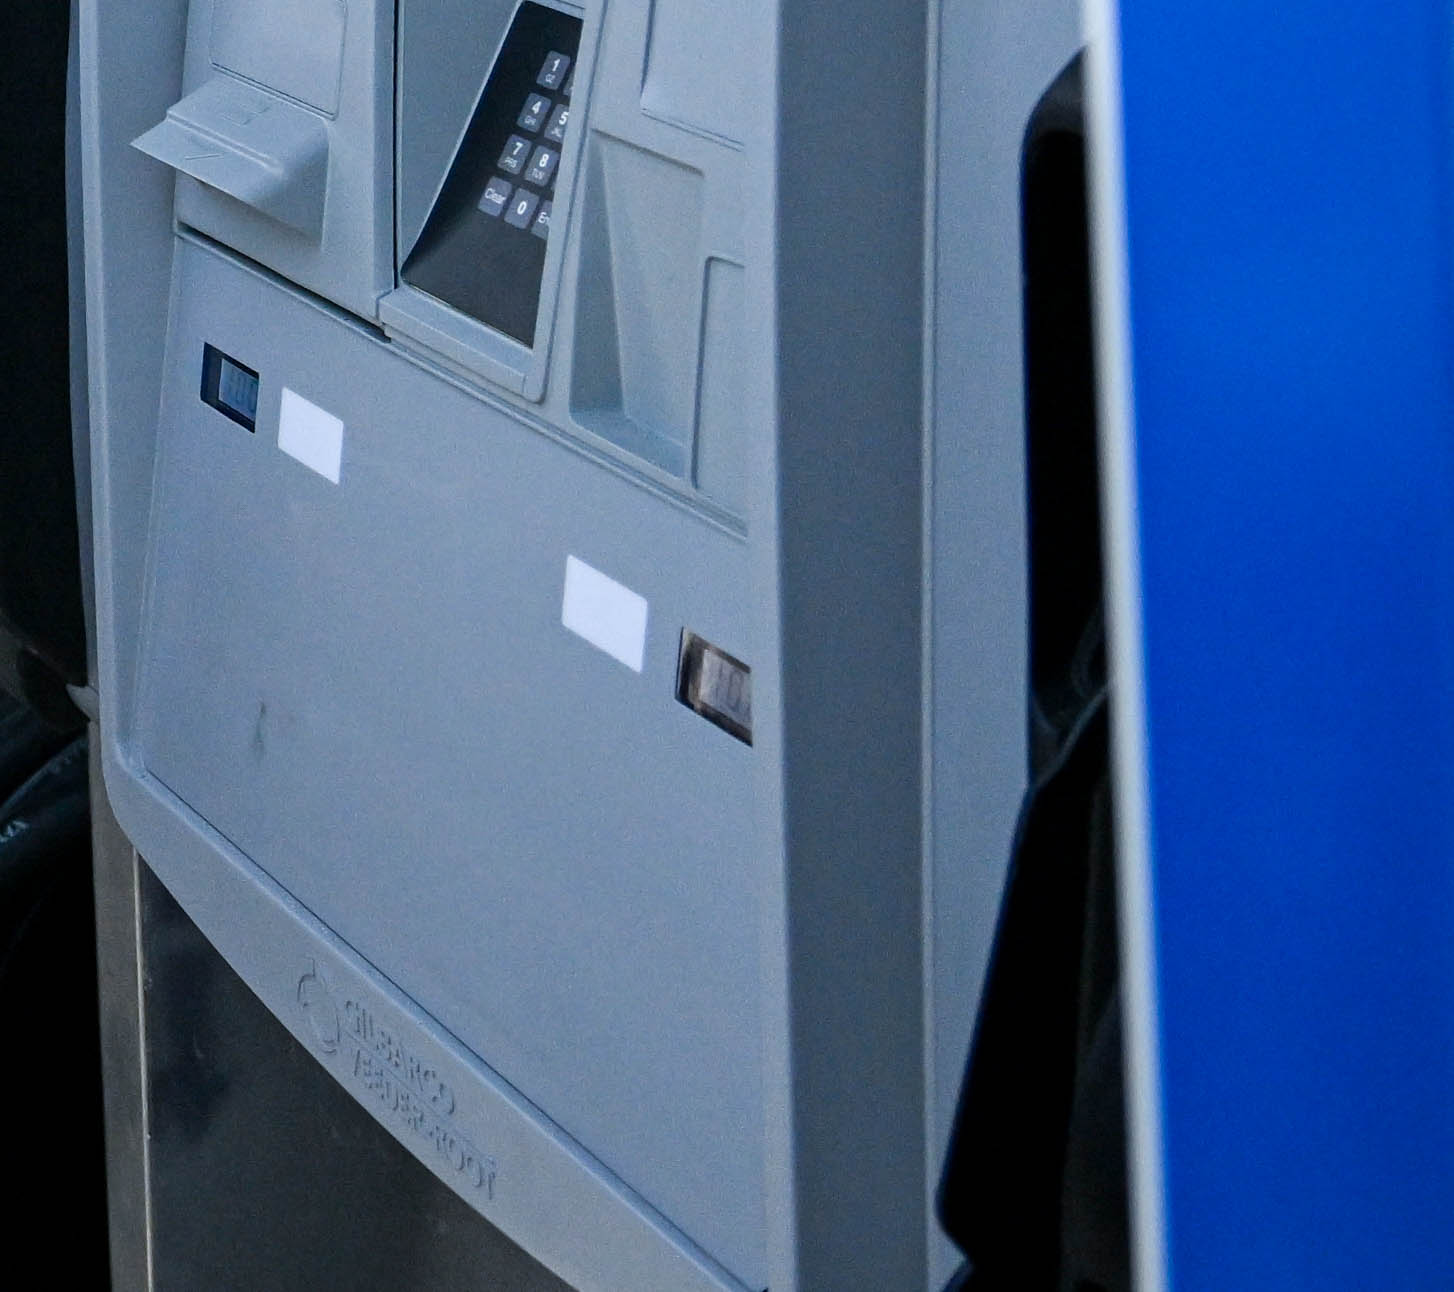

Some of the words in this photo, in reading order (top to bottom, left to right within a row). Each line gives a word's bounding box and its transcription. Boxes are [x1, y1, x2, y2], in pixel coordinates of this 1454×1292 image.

[552, 58, 561, 73] 1
[531, 100, 542, 115] 4
[558, 111, 569, 125] 5
[512, 141, 524, 156] 7
[538, 153, 550, 168] 8
[485, 187, 507, 206] Clear
[516, 200, 528, 215] 0
